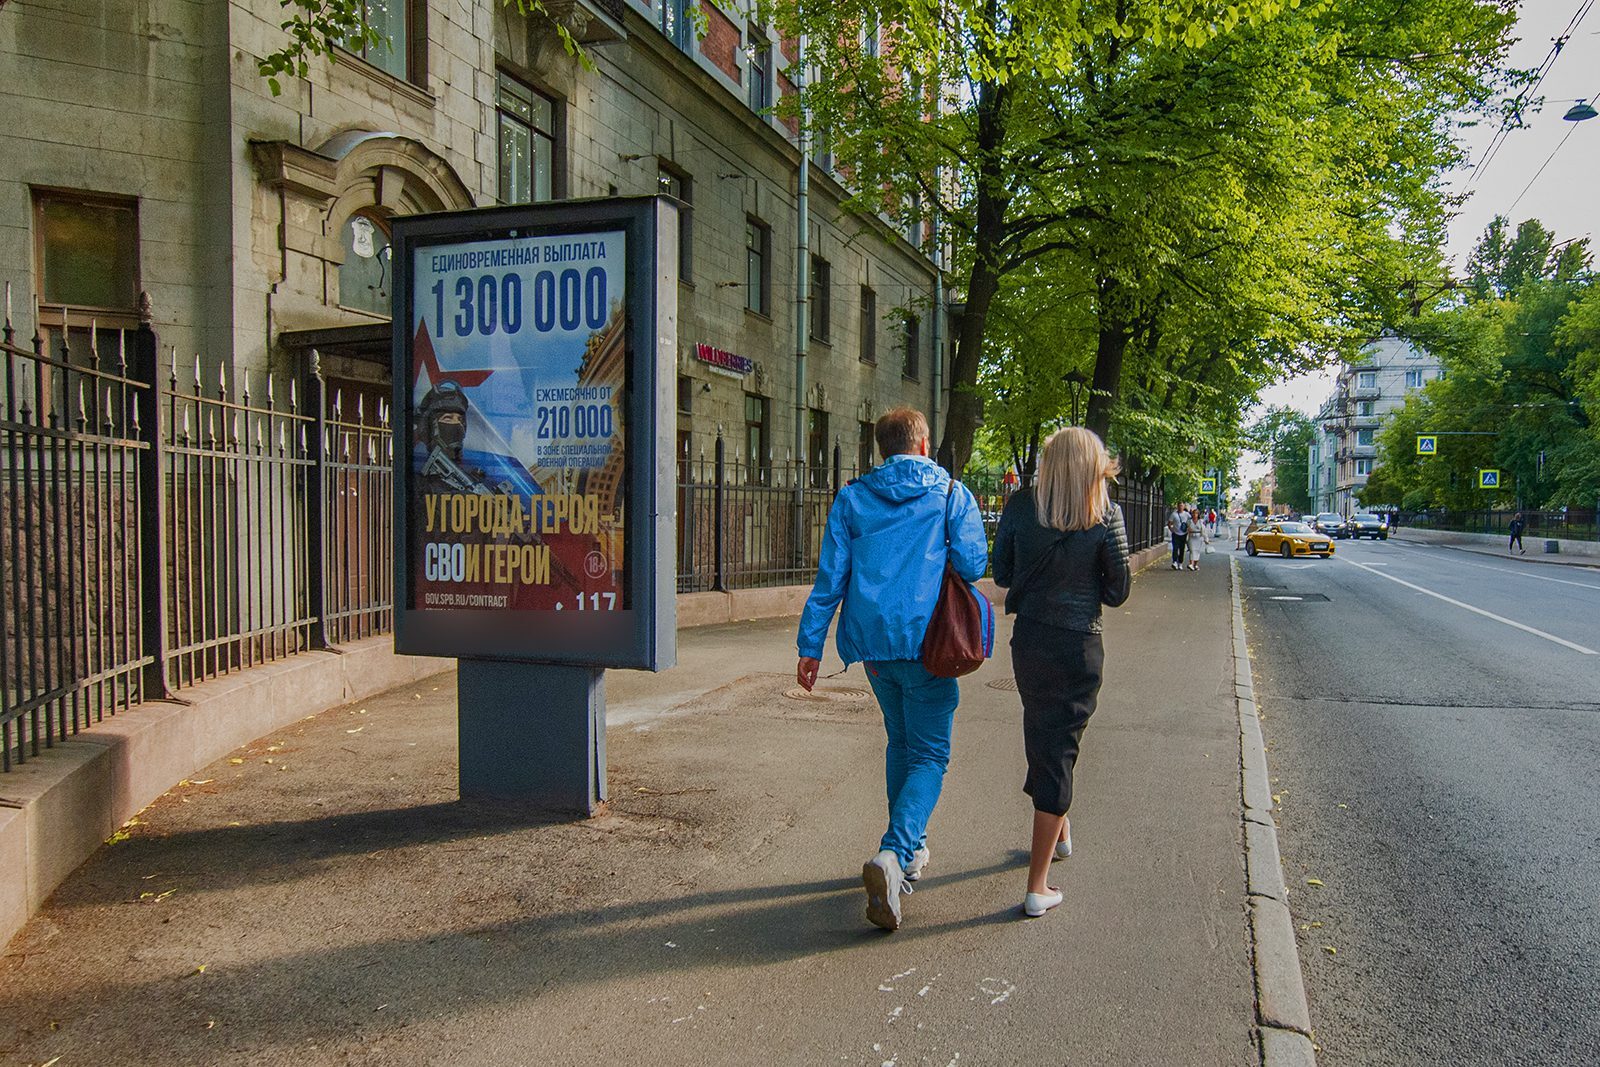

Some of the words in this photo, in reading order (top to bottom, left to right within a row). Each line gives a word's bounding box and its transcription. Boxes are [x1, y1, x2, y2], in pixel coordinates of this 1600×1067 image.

[432, 246, 540, 274] ЕДИНОВРЕМЕННАЯ
[544, 241, 606, 263] ВЫПЛАТА
[431, 279, 444, 338] 1
[455, 273, 522, 337] 300
[534, 266, 608, 332] 000
[536, 387, 598, 401] ЕЖЕМЕСЯЧНО
[600, 386, 612, 400] ОТ
[537, 405, 570, 439] 210
[575, 404, 612, 439] 000
[537, 446, 542, 455] В
[543, 445, 560, 455] ЗОНЕ
[561, 443, 612, 456] СПЕЦИАЛЬНОЙ
[537, 455, 567, 467] ВОЕННОЙ
[568, 456, 606, 468] ОПЕРАЦИИ
[425, 495, 438, 533] У
[439, 494, 599, 538] ГОРОДА-ГЕРОЯ
[425, 542, 479, 583] СВОИ
[484, 544, 550, 585] ГЕРОИ
[588, 555, 604, 573] 18+
[425, 592, 508, 608] GOV.SPB.RU/CONTRACT
[576, 591, 616, 611] 117
